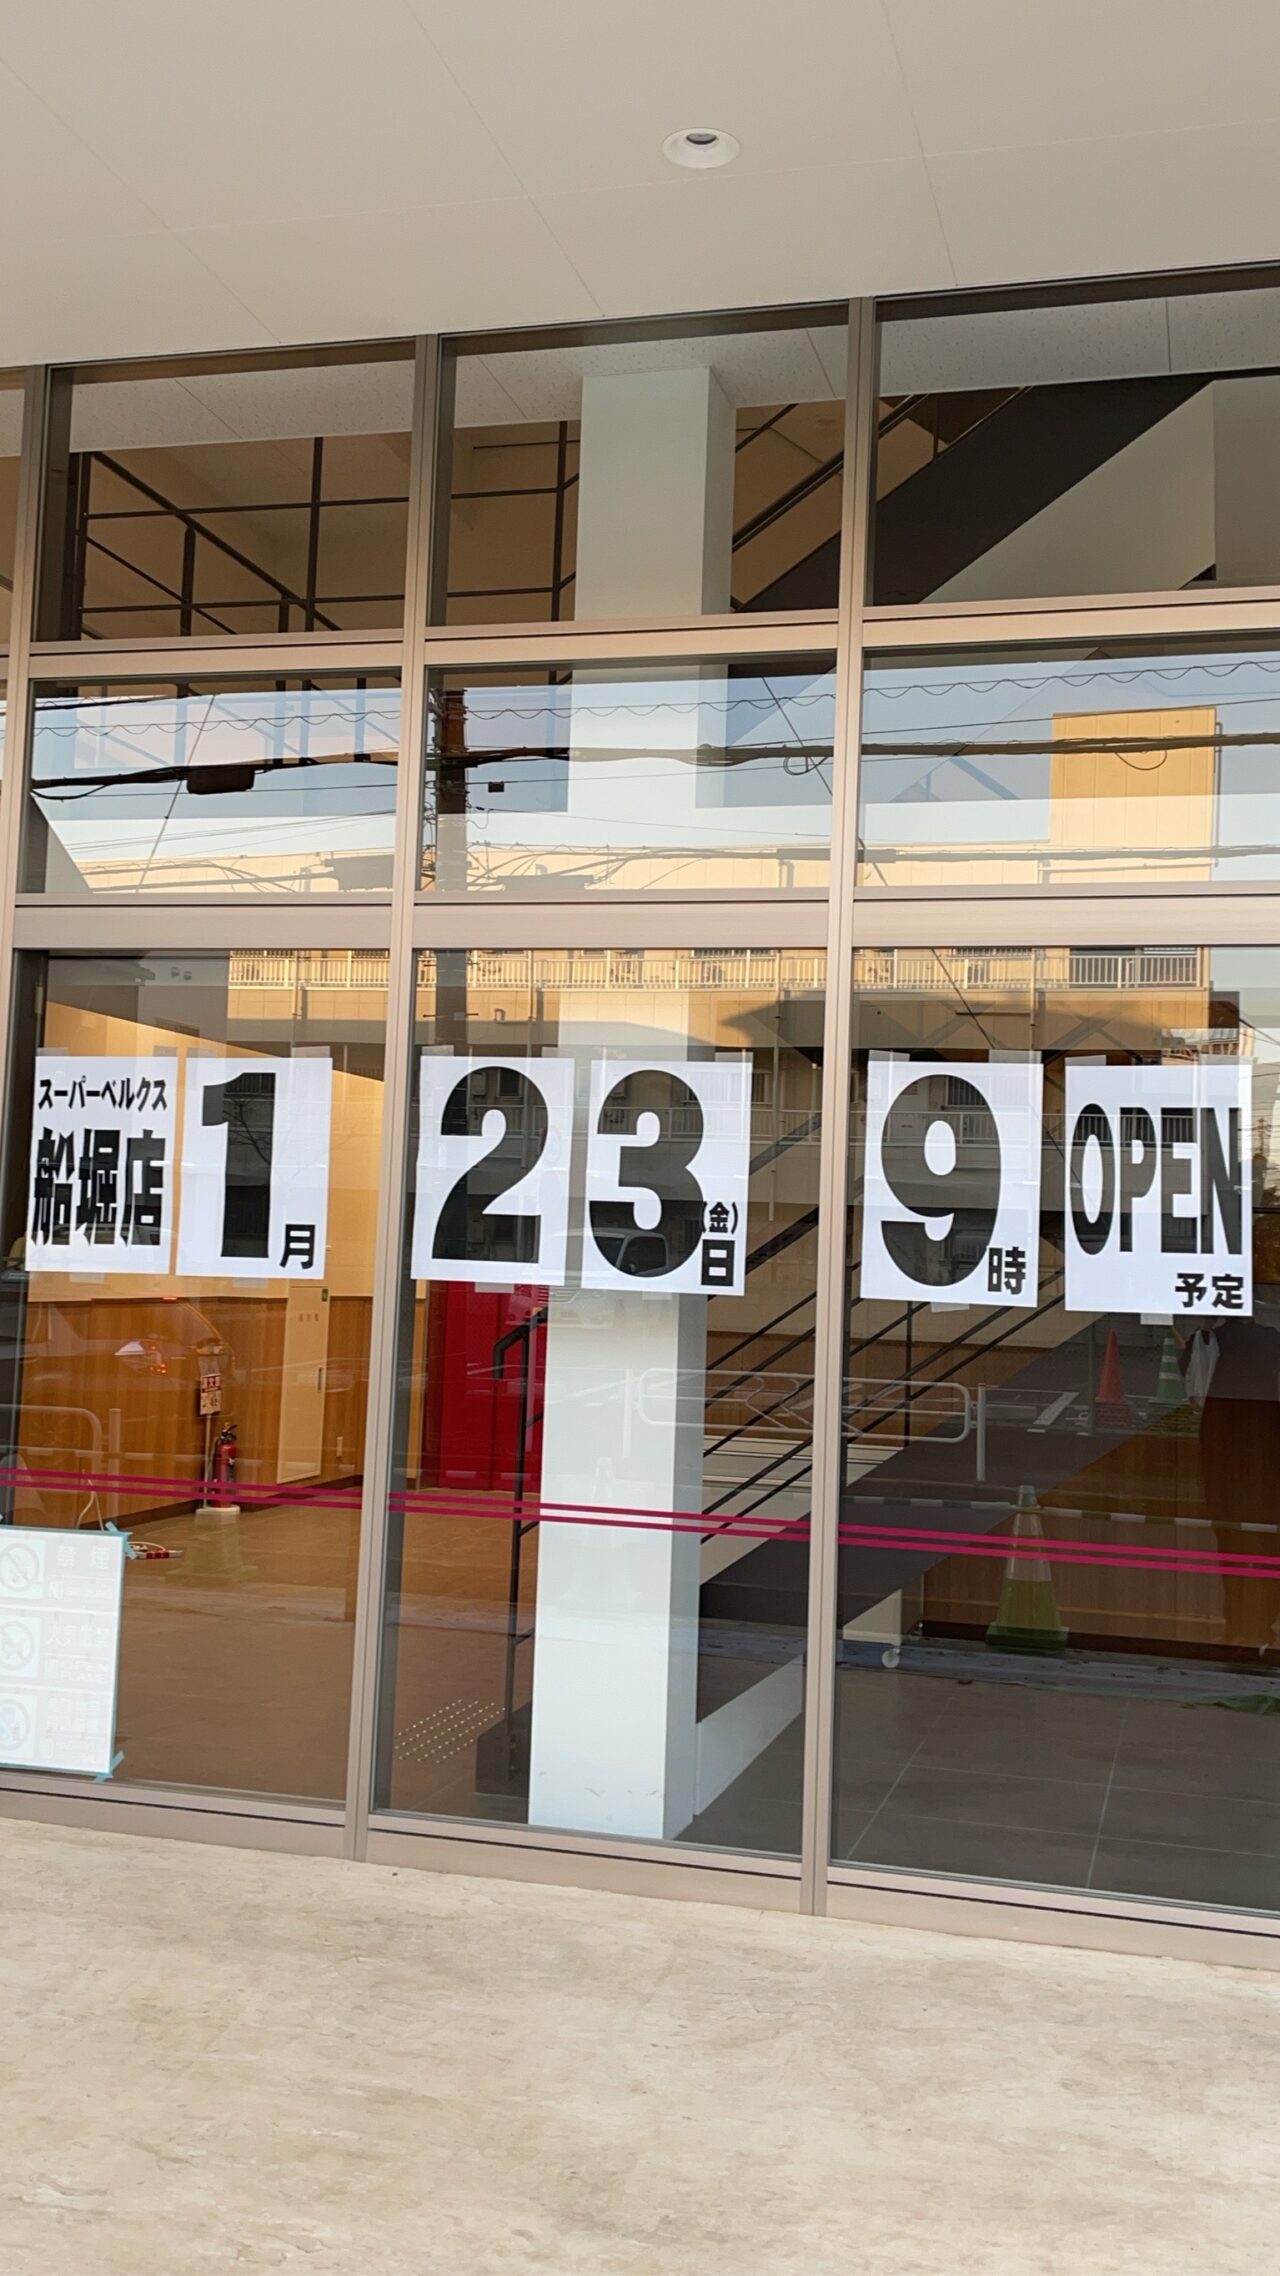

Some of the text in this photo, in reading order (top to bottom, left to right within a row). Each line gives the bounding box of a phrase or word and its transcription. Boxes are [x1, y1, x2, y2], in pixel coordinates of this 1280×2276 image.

[38, 1075, 168, 1112] スーパーベルクス
[31, 1126, 167, 1246] 船堀店
[1069, 1103, 1243, 1256] OPEN
[1175, 1272, 1244, 1309] 予定
